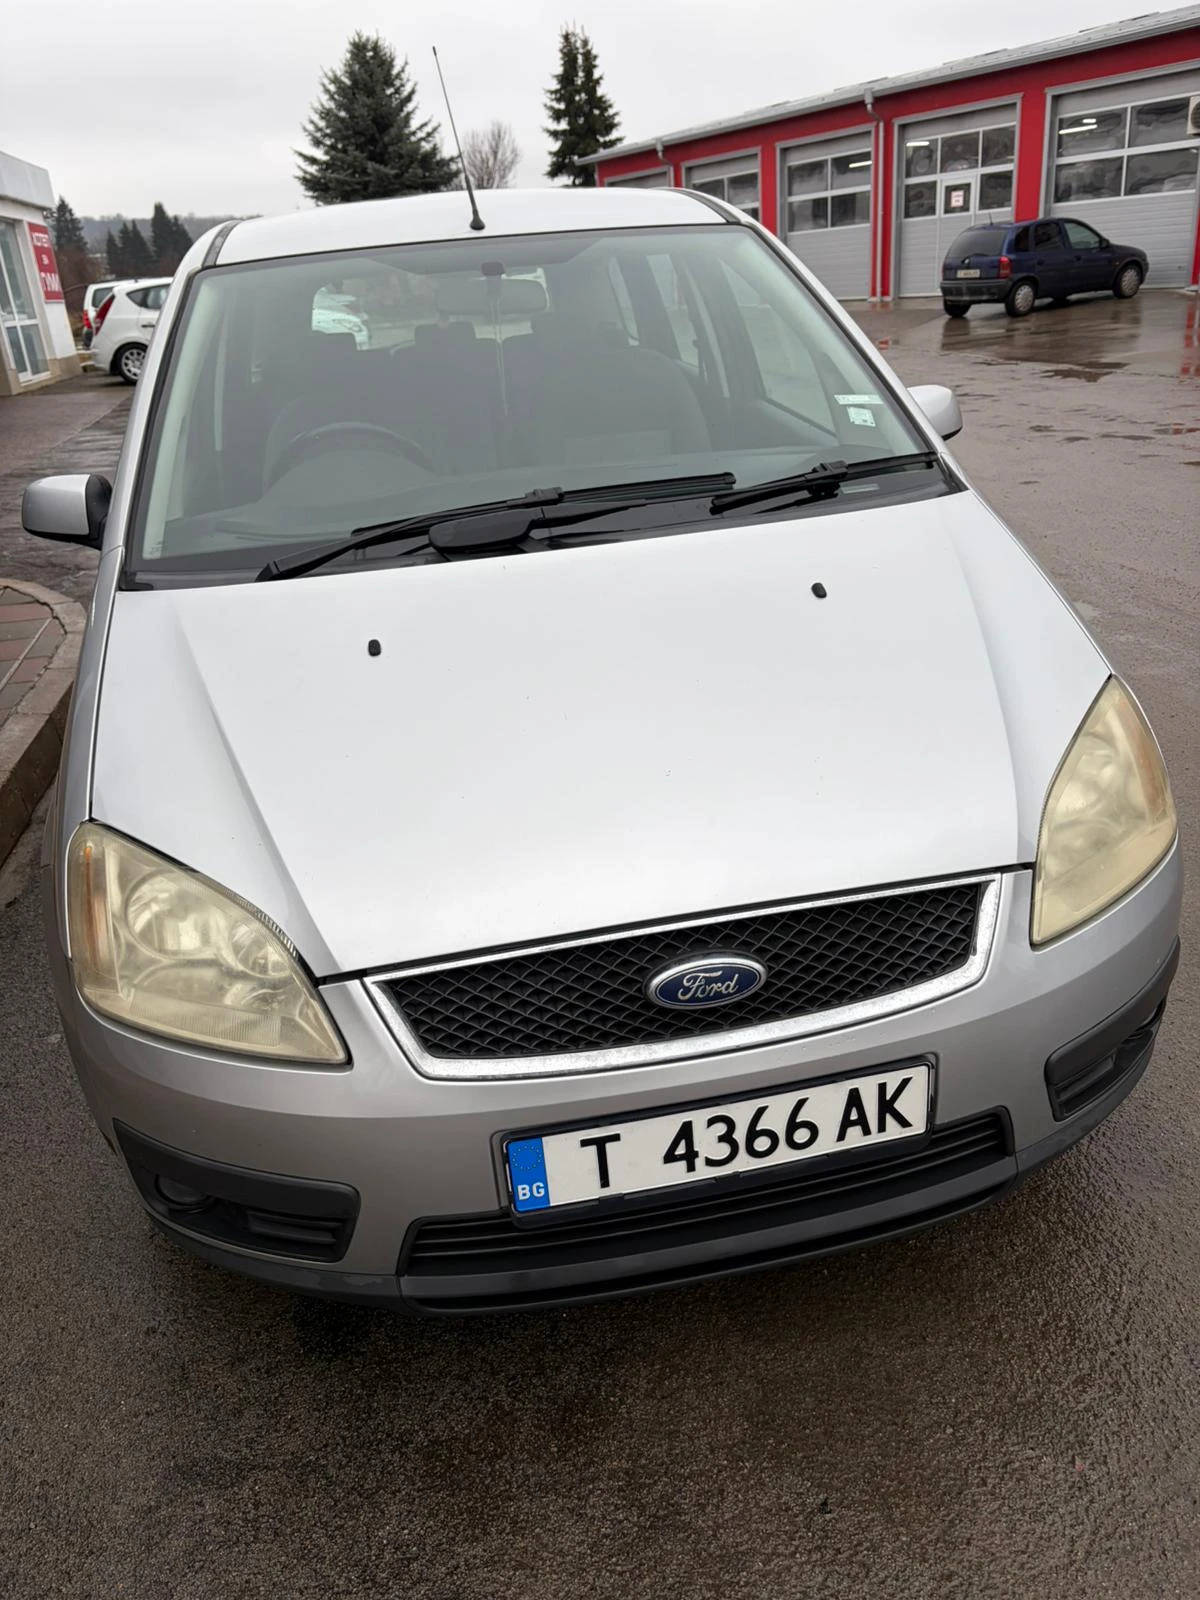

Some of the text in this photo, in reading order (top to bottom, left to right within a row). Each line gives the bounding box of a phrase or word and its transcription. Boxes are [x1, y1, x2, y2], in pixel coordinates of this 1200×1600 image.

[678, 970, 740, 1001] Ford
[580, 1077, 913, 1189] T 4366 AK
[517, 1182, 545, 1200] BG
